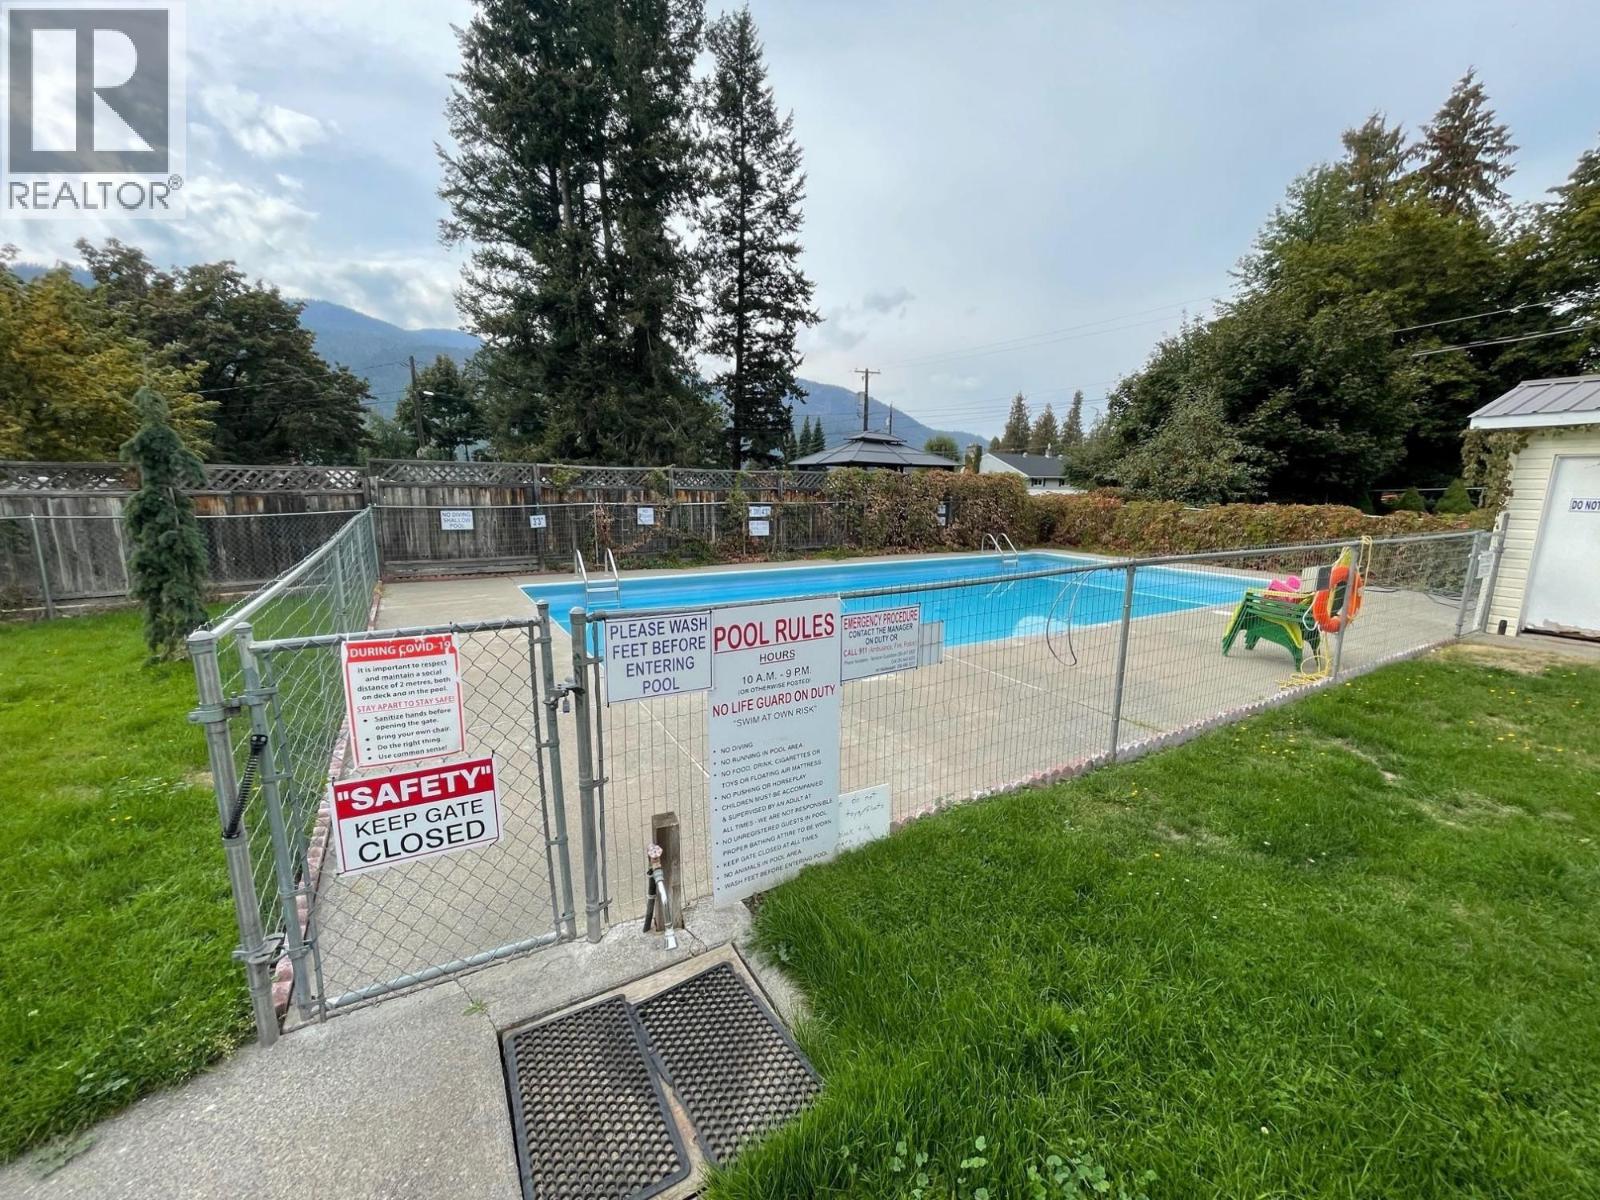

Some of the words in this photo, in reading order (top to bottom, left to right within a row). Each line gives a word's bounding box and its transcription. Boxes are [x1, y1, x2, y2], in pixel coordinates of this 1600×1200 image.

[1572, 500, 1583, 510] DO
[610, 622, 665, 640] PLEASE
[670, 617, 707, 634] WASH
[844, 614, 881, 630] EMERGENCY
[883, 610, 917, 624] PROCEDURE
[714, 622, 769, 651] POOL
[776, 613, 834, 642] RULES
[849, 628, 874, 638] CONTACT
[888, 623, 913, 632] MANAGER
[350, 645, 396, 658] DURING
[613, 642, 648, 659] FEET
[653, 636, 706, 655] BEFORE
[760, 650, 796, 662] HOURS
[844, 649, 857, 657] CALL
[373, 664, 410, 672] important
[382, 672, 414, 680] maintain
[627, 656, 694, 677] ENTERING
[742, 675, 753, 684] 10
[756, 671, 777, 683] A.M.
[786, 670, 791, 678] 9
[794, 666, 811, 676] P.M.
[643, 677, 679, 694] POOL
[750, 682, 786, 693] OTHERWISE
[377, 702, 402, 710] APART
[712, 704, 728, 718] NO
[732, 698, 753, 714] LIFE
[756, 692, 791, 709] GUARD
[794, 690, 808, 701] ON
[811, 684, 835, 699] DUTY
[374, 713, 404, 722] Sanitize
[762, 712, 771, 722] AT
[774, 709, 793, 719] OWN
[376, 722, 406, 730] opening
[393, 750, 424, 758] common
[732, 742, 753, 752] DIVING
[732, 752, 760, 762] RUNNING
[775, 752, 810, 764] CIGARETTES
[722, 780, 738, 788] TOYS
[750, 769, 779, 781] FLOATING
[792, 760, 821, 772] MATTRESS
[337, 765, 490, 810] "SAFETY"
[722, 799, 753, 811] CHILDREN
[782, 780, 823, 795] ACCOMPANIED
[733, 786, 760, 797] PUSHING
[773, 774, 806, 786] HORSEPLAY
[355, 813, 417, 838] KEEP
[425, 799, 484, 823] GATE
[728, 805, 766, 821] SUPERVISED
[785, 796, 803, 805] ADULT
[735, 821, 753, 830] TIMES
[795, 798, 832, 812] RESPONSIBLE
[734, 823, 779, 841] UNREGISTERED
[782, 817, 803, 826] GUESTS
[812, 810, 826, 818] POOL
[358, 820, 485, 863] CLOSED
[723, 845, 748, 856] PROPER
[749, 836, 775, 848] BATHING
[777, 830, 796, 840] ATTIRE
[815, 820, 831, 829] WORN
[724, 859, 739, 867] KEEP
[741, 853, 756, 862] GATE
[758, 845, 781, 856] CLOSED
[802, 834, 818, 842] TIMES
[734, 863, 760, 874] ANIMALS
[786, 849, 801, 857] AREA
[725, 880, 742, 889] WASH
[744, 873, 759, 882] FEET
[760, 866, 783, 877] BEFORE
[785, 856, 812, 869] ENTERING
